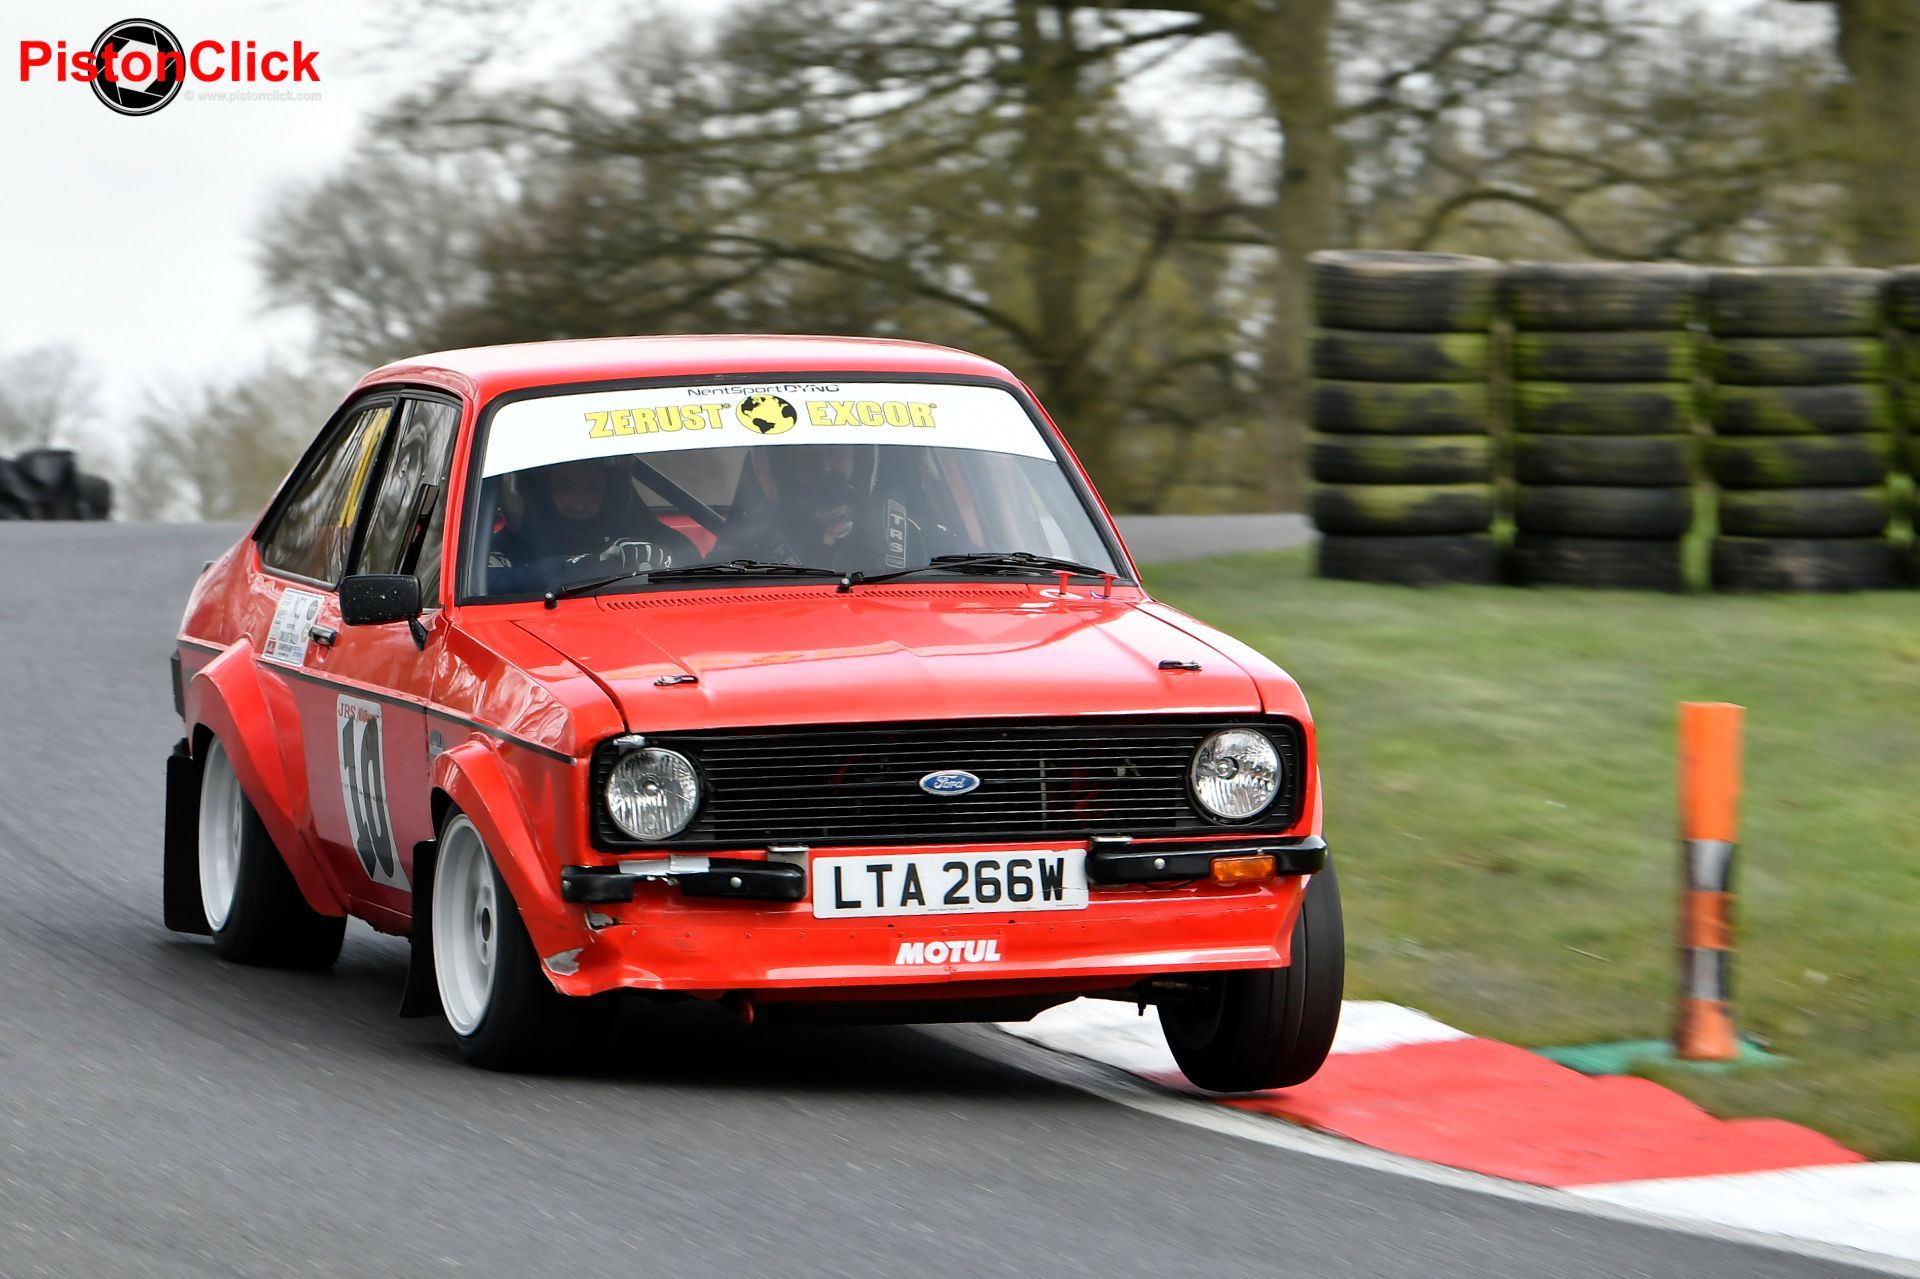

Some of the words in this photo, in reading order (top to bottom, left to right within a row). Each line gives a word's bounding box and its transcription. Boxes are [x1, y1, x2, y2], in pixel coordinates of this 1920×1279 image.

[342, 716, 395, 880] 10
[933, 776, 966, 789] Ford
[833, 862, 926, 909] LTA
[943, 858, 1064, 904] 266W
[895, 939, 1001, 965] MOTUL
